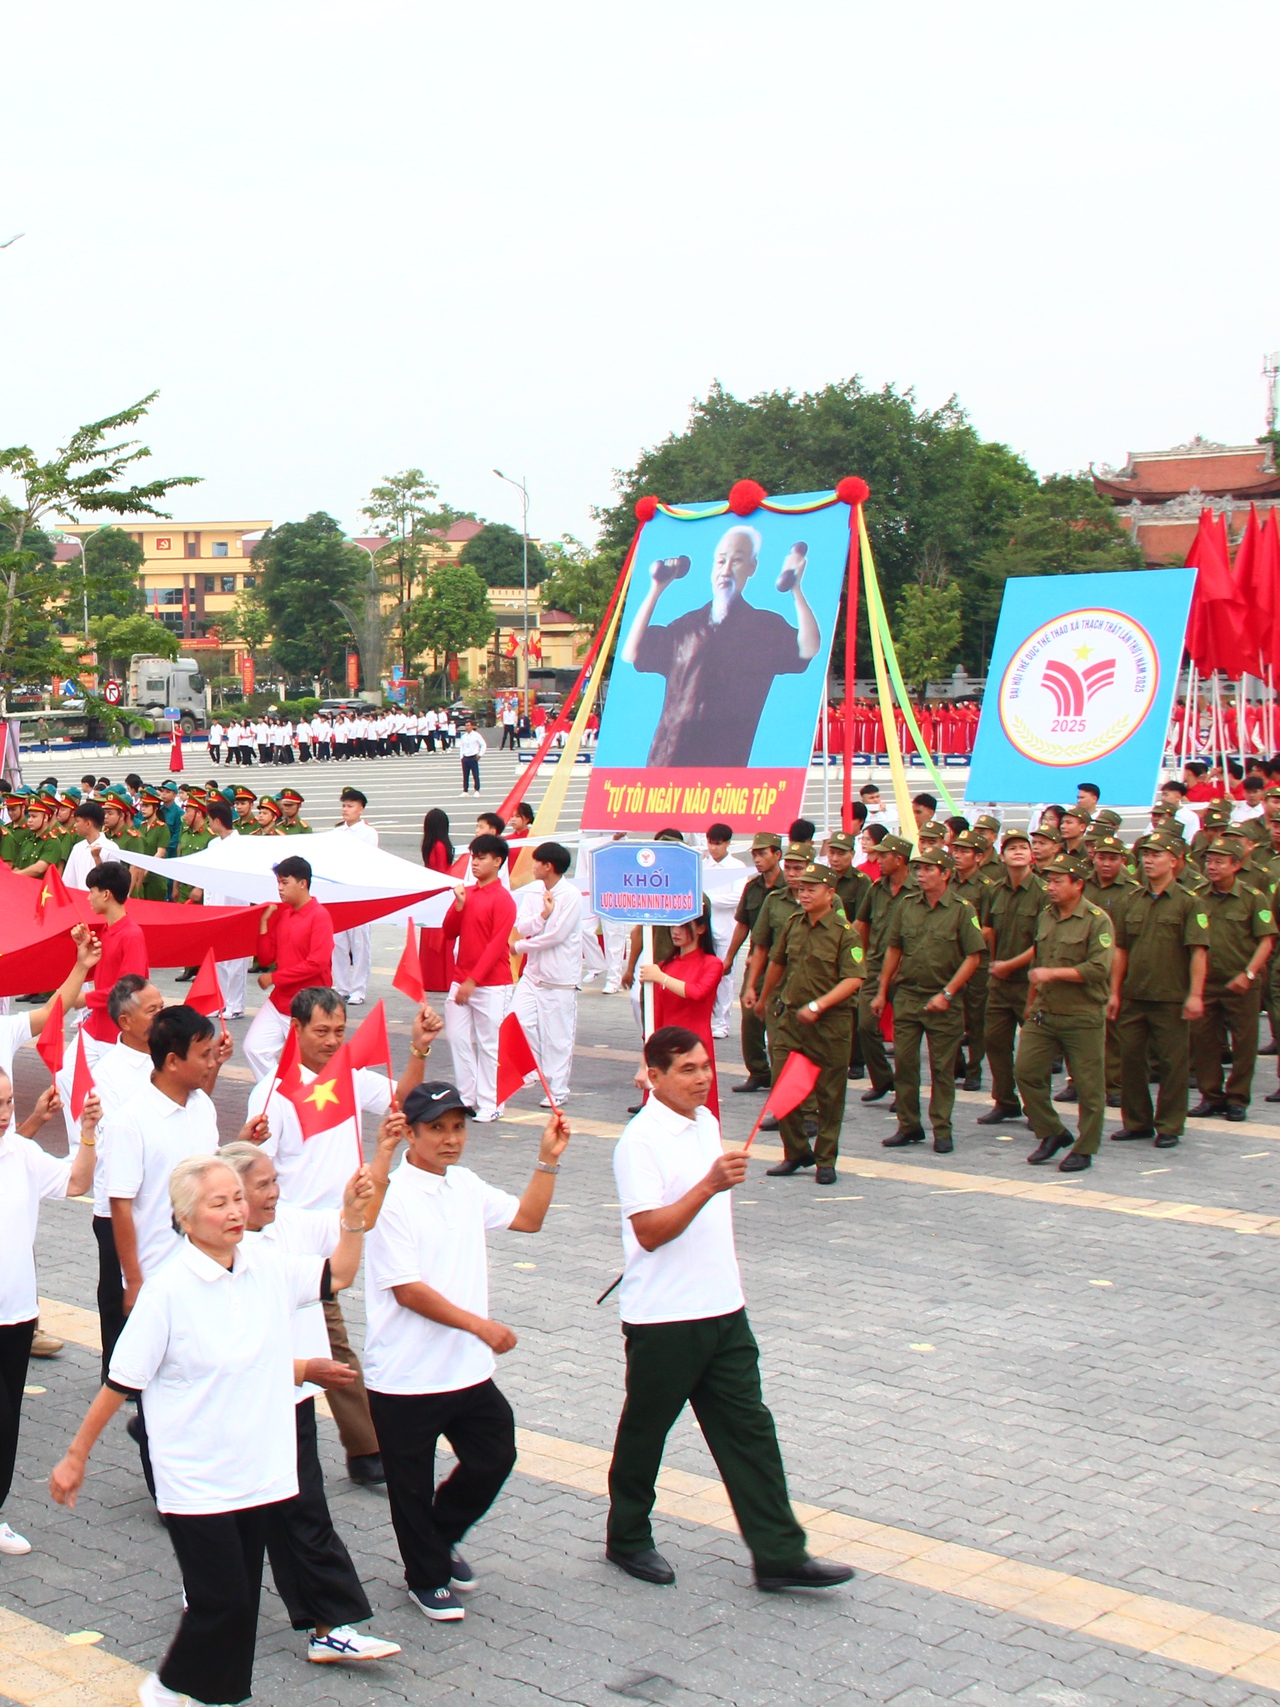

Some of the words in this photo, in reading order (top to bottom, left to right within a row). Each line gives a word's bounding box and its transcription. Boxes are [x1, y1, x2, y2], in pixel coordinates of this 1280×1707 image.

[1050, 624, 1068, 640] THAO
[1081, 619, 1105, 632] THẠCH
[1134, 676, 1147, 694] 2025
[1050, 719, 1087, 733] 2025
[625, 782, 646, 814] TÔI
[646, 782, 682, 814] NGÀY
[681, 783, 710, 815] NÀO
[711, 783, 750, 816] CŨNG
[623, 868, 670, 888] KHỐI
[600, 892, 613, 910] LỰC
[614, 892, 636, 912] LƯỢNG
[637, 893, 648, 908] AN
